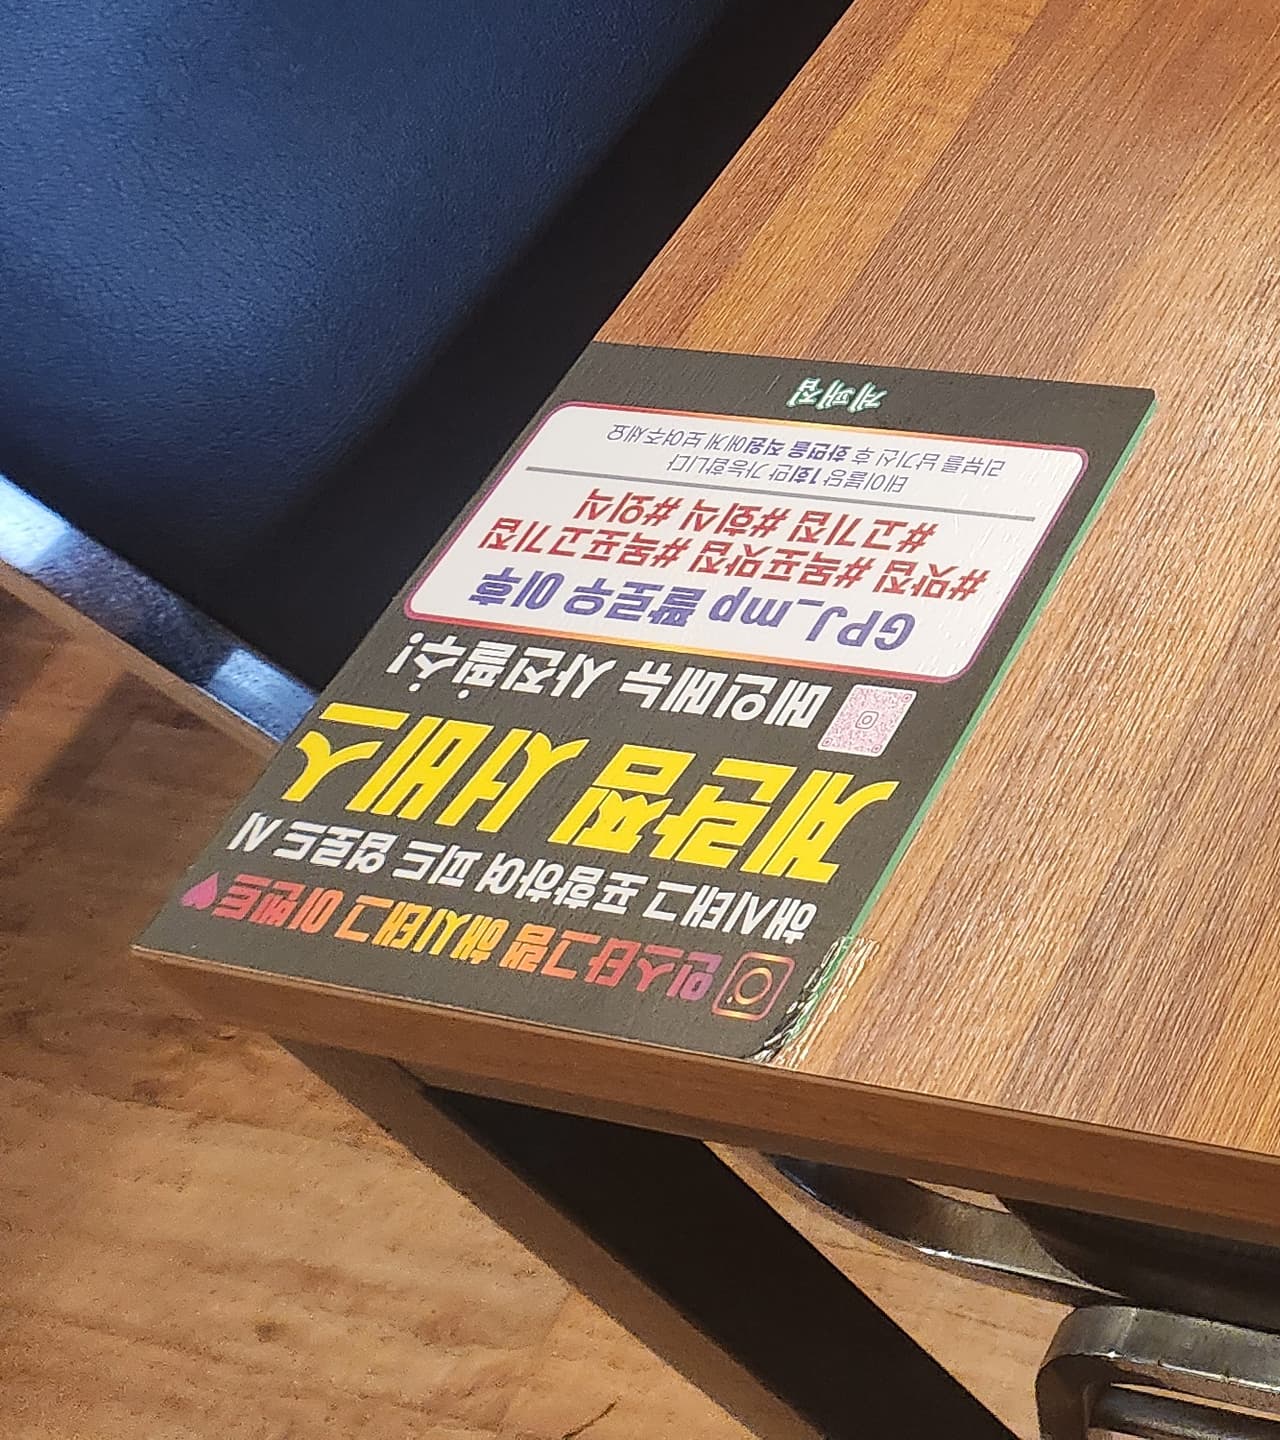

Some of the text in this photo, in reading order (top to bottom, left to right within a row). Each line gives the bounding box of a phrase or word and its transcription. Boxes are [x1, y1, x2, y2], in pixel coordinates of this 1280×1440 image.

[605, 422, 1006, 477] 리뷰를 남기신 후 화면을 직원에게 보여주세요
[664, 452, 909, 493] 테이블당 1회만 가능합니다
[476, 516, 990, 602] #맛집 #목포맛집 #목포고기집
[571, 486, 938, 553] #고기집 #회식 #외식
[467, 565, 916, 651] GPJ_mp 팔로우 이후
[383, 629, 832, 728] 메인메뉴 사진필수!
[280, 701, 899, 883] 계란찜 서비스
[224, 810, 817, 944] 해시태그 포함하여 피드 업로드 시
[209, 872, 722, 1001] 인스타그램 해시태그 이벤트
